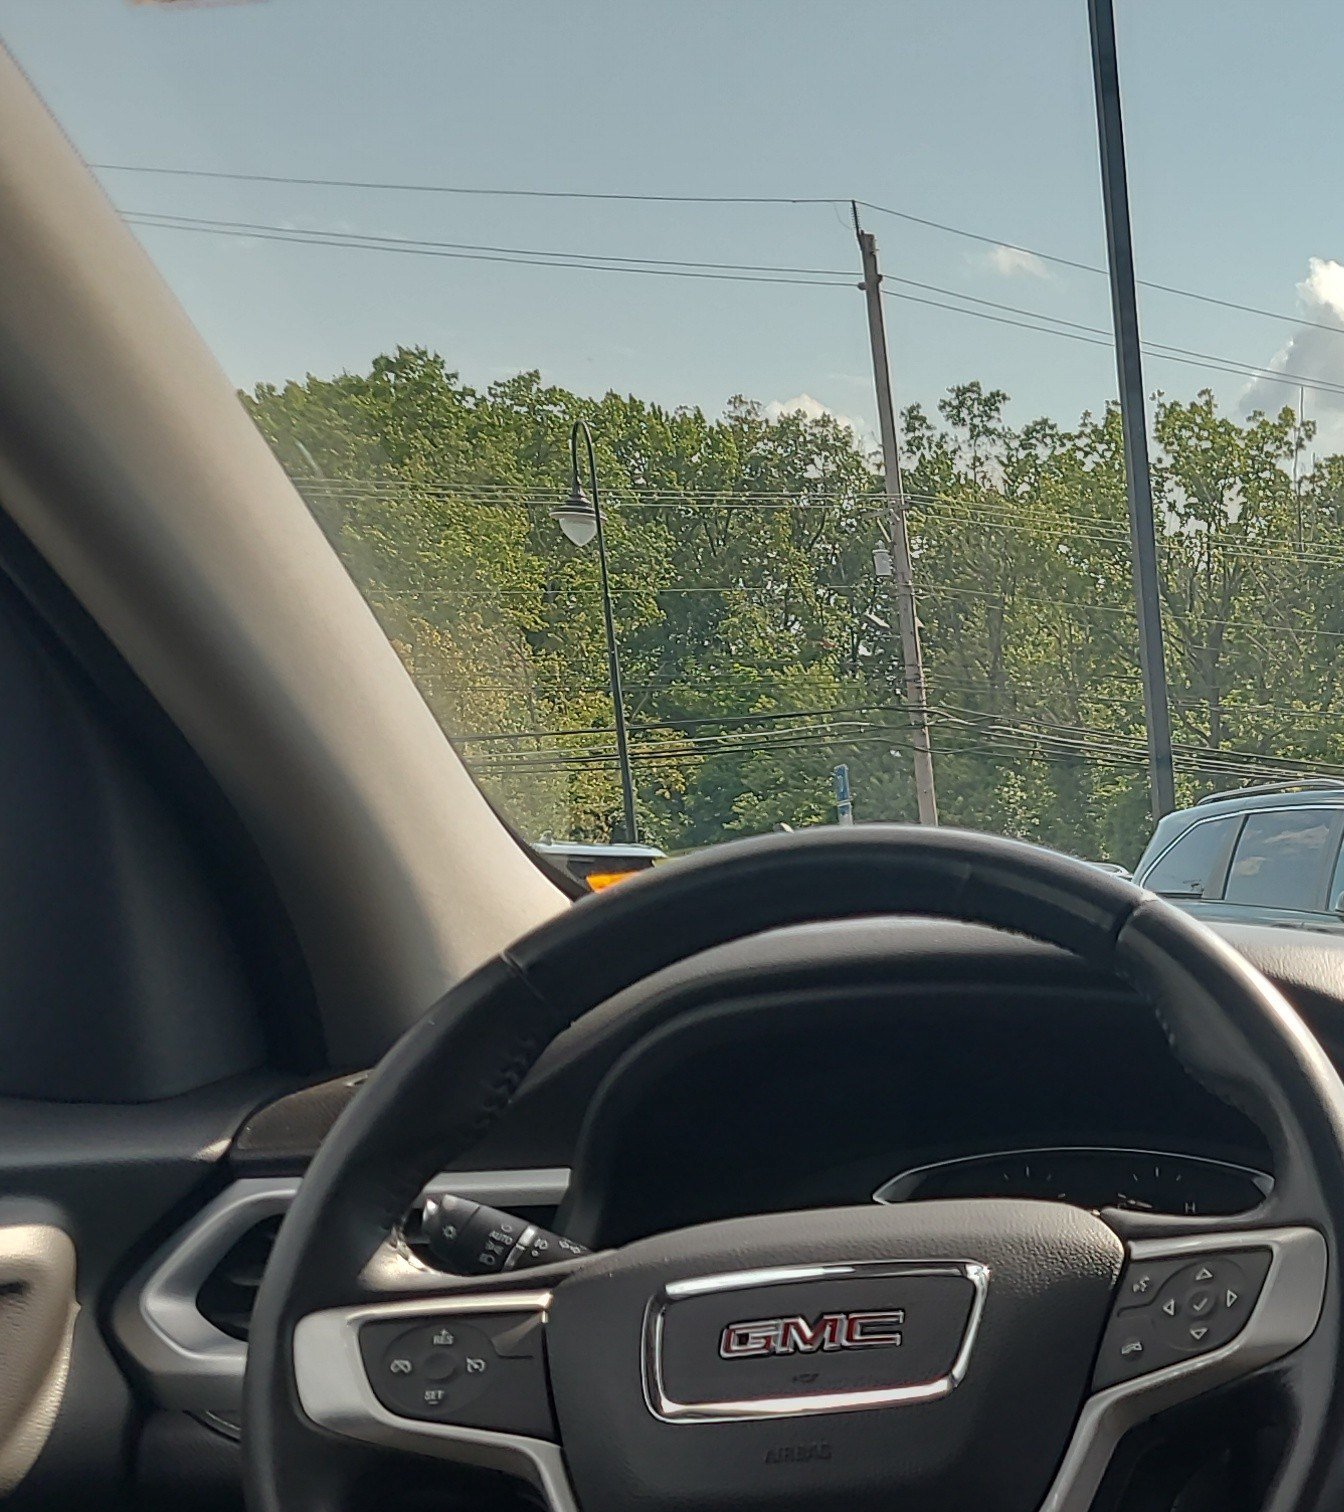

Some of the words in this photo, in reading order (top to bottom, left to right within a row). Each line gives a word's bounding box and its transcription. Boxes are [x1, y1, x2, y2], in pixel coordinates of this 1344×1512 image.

[489, 1230, 513, 1245] AUTO
[433, 1334, 454, 1345] RES
[719, 1309, 904, 1359] GMC
[424, 1390, 445, 1401] SET
